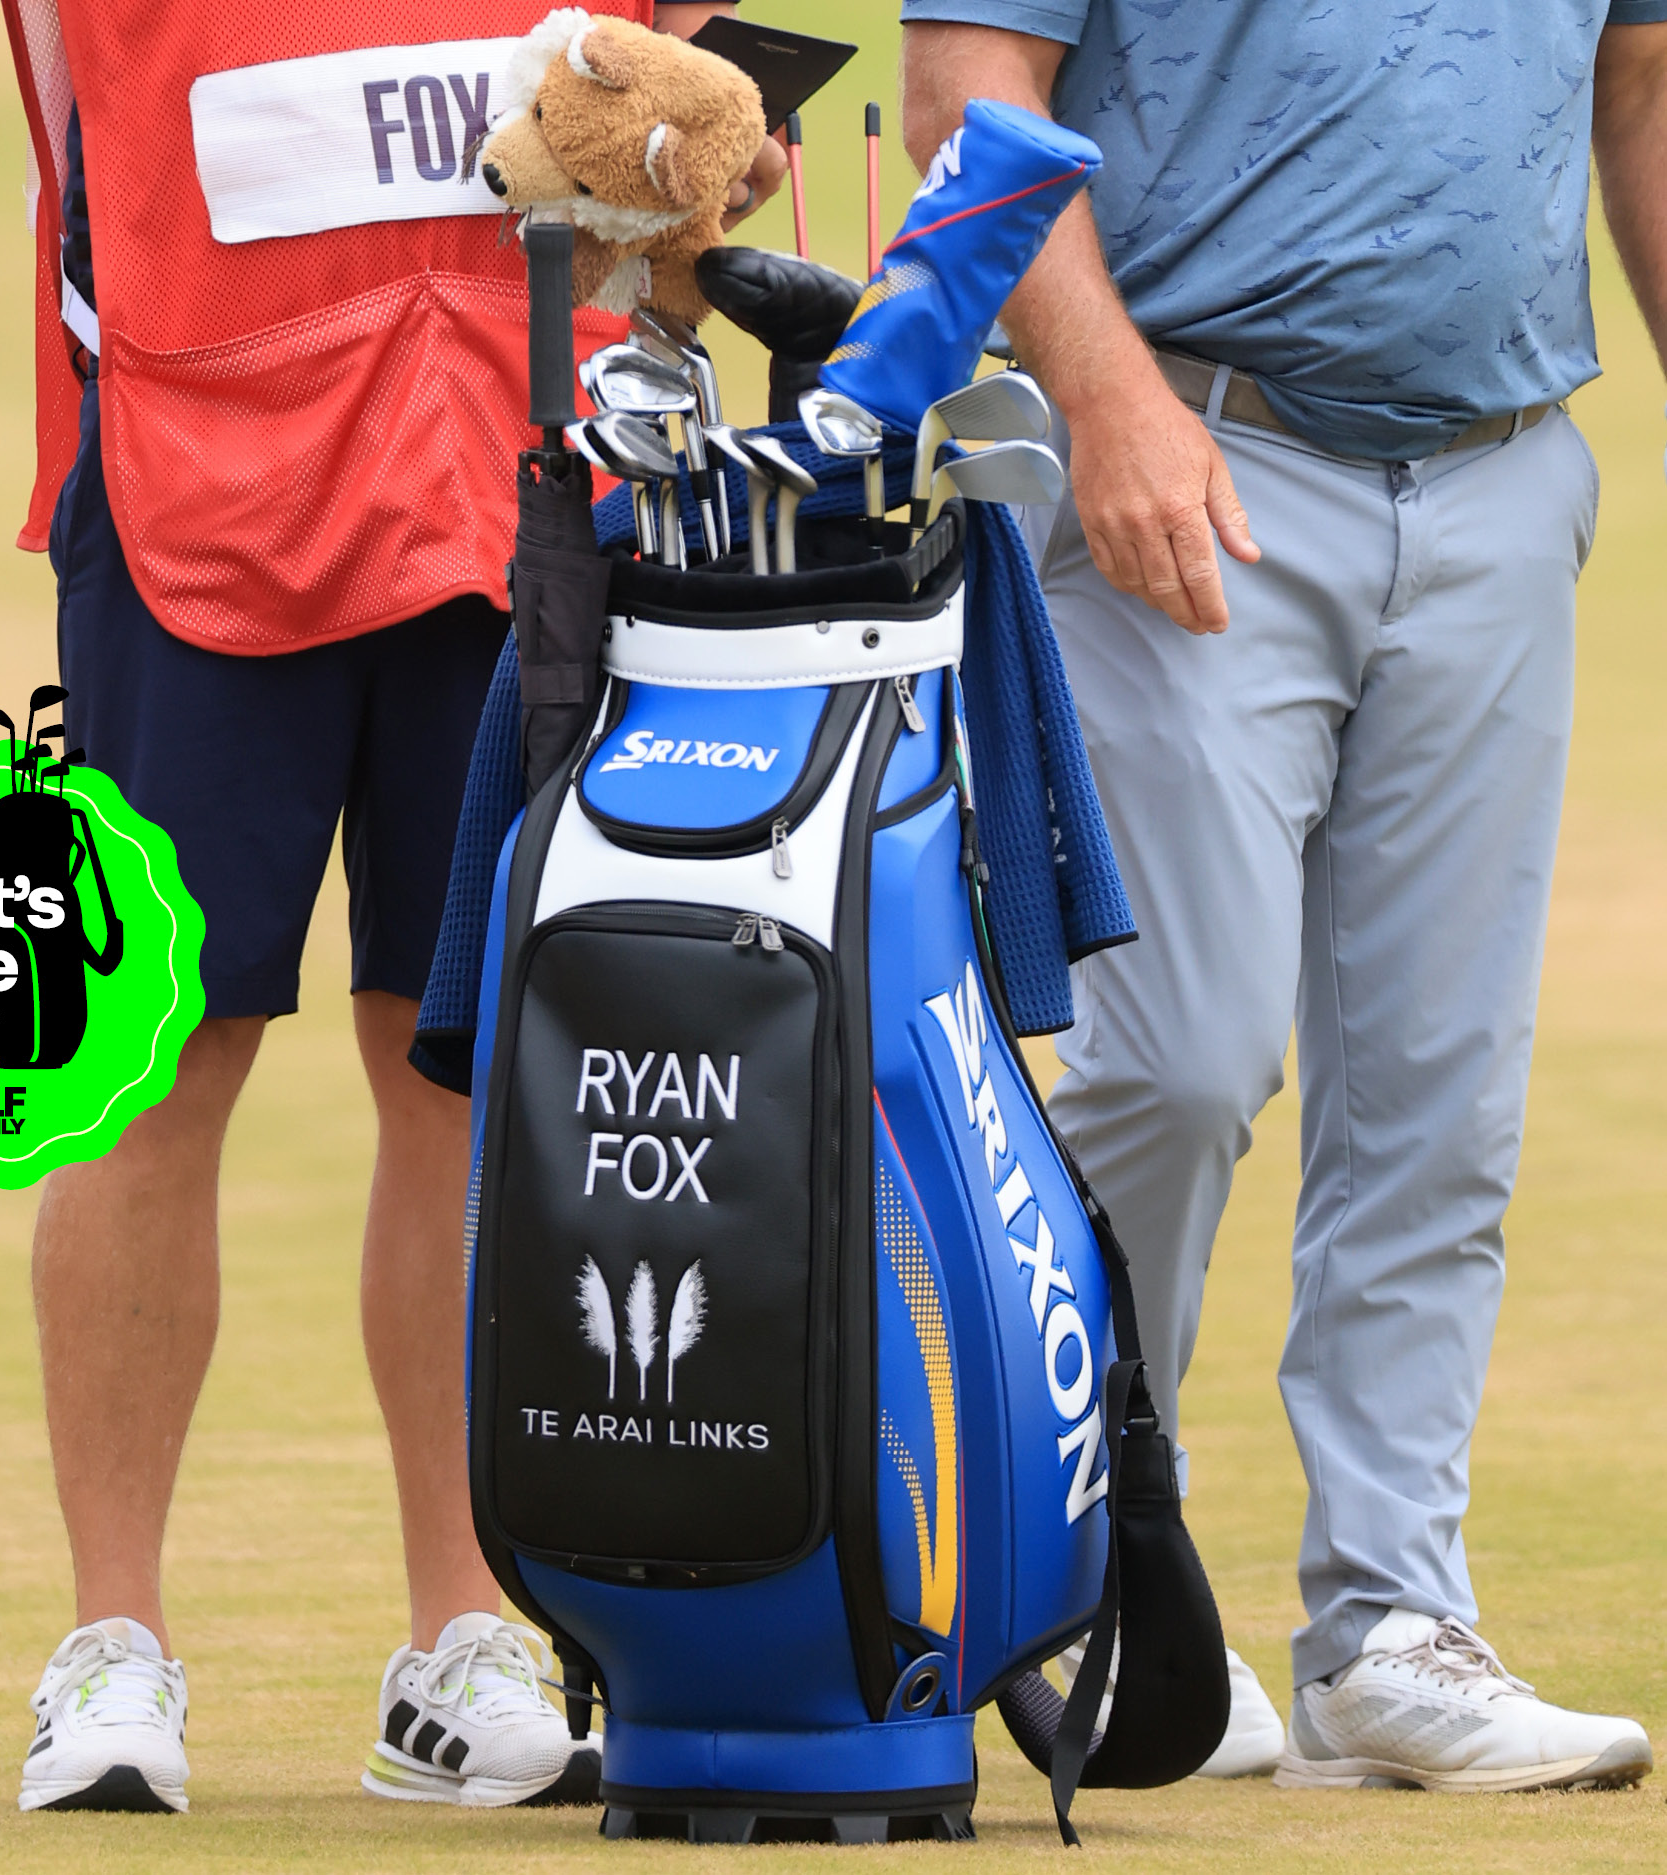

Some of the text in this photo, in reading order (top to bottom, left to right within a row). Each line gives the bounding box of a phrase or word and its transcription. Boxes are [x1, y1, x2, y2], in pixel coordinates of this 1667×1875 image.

[362, 72, 490, 184] FOX
[599, 730, 780, 773] SRIXON
[576, 1048, 741, 1120] RYAN
[584, 1131, 713, 1203] FOX
[925, 960, 1110, 1526] SRIXON
[521, 1408, 770, 1450] TE ARAI LINKS
